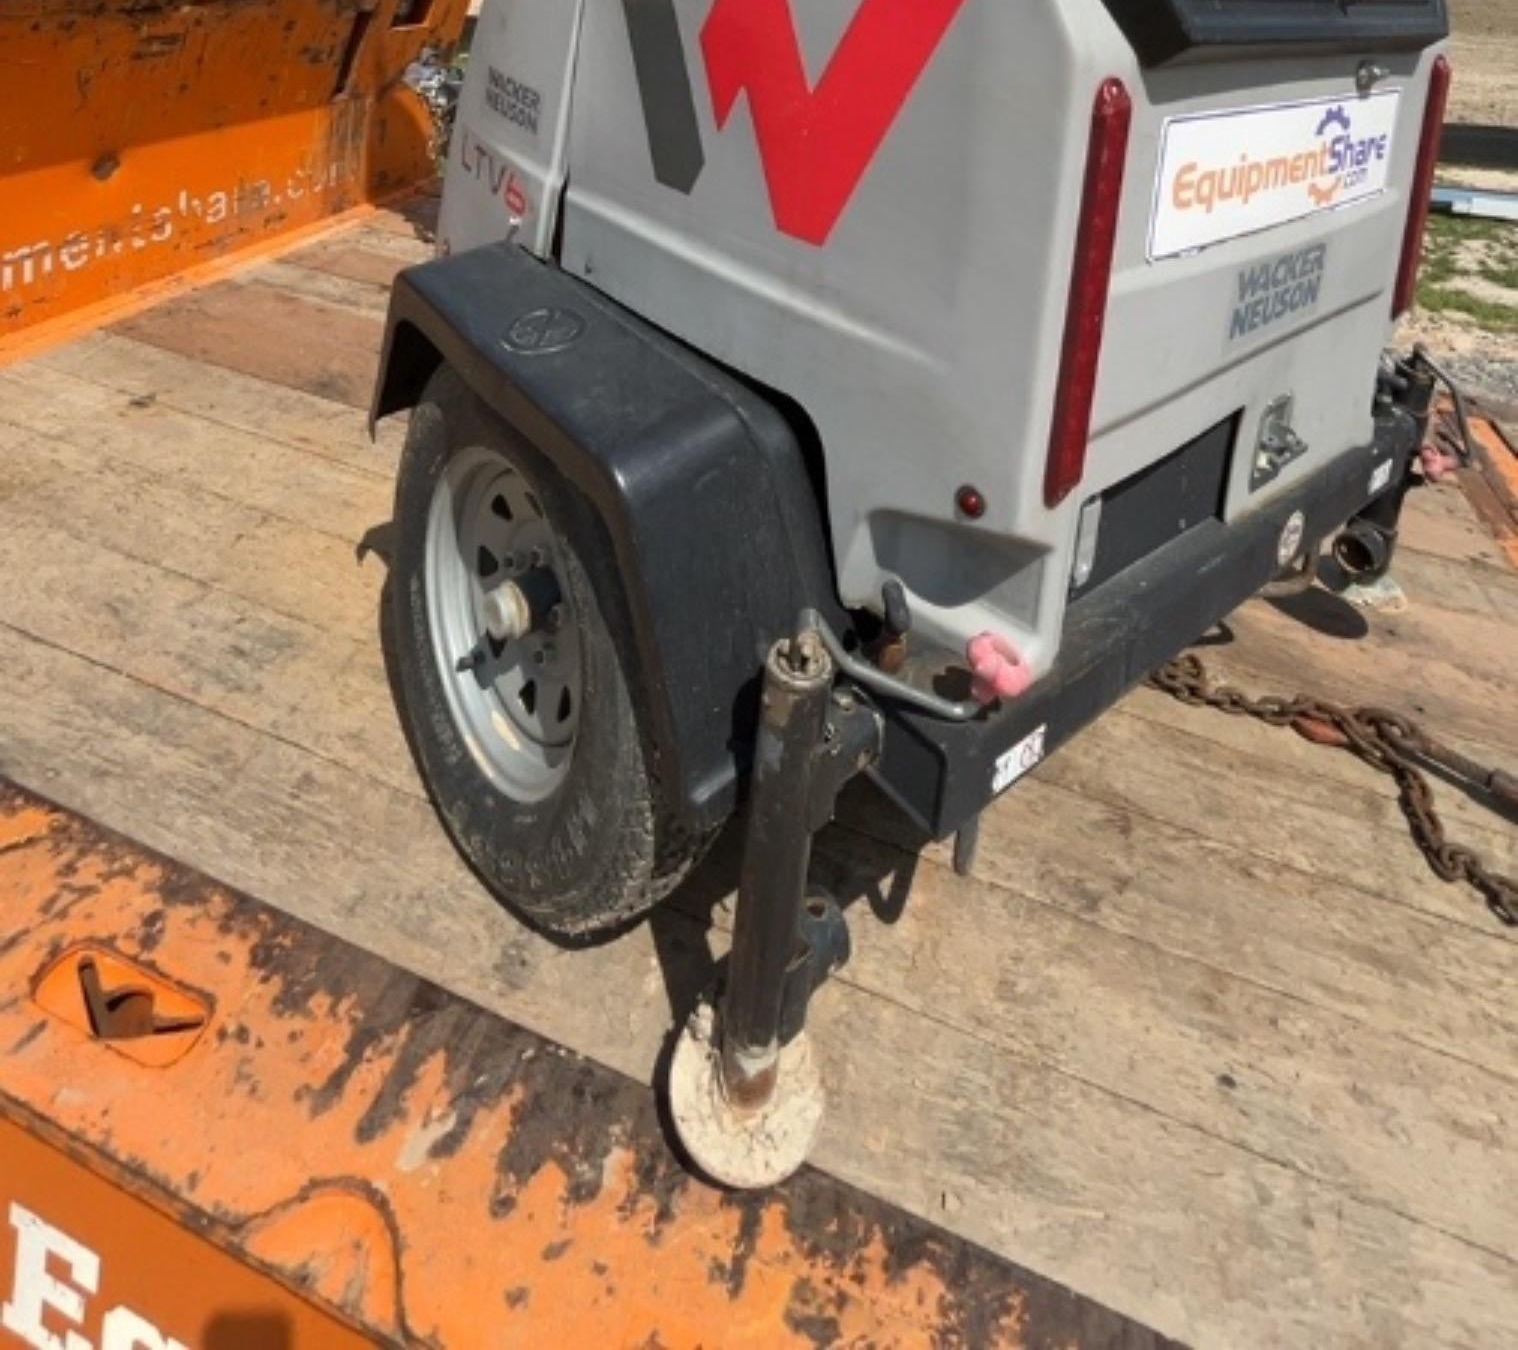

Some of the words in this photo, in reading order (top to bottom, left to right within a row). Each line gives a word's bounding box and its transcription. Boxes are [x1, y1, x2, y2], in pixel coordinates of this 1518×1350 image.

[1172, 134, 1387, 214] EquipmentShare
[1238, 242, 1327, 302] WACKER
[1229, 273, 1320, 340] NEUSON
